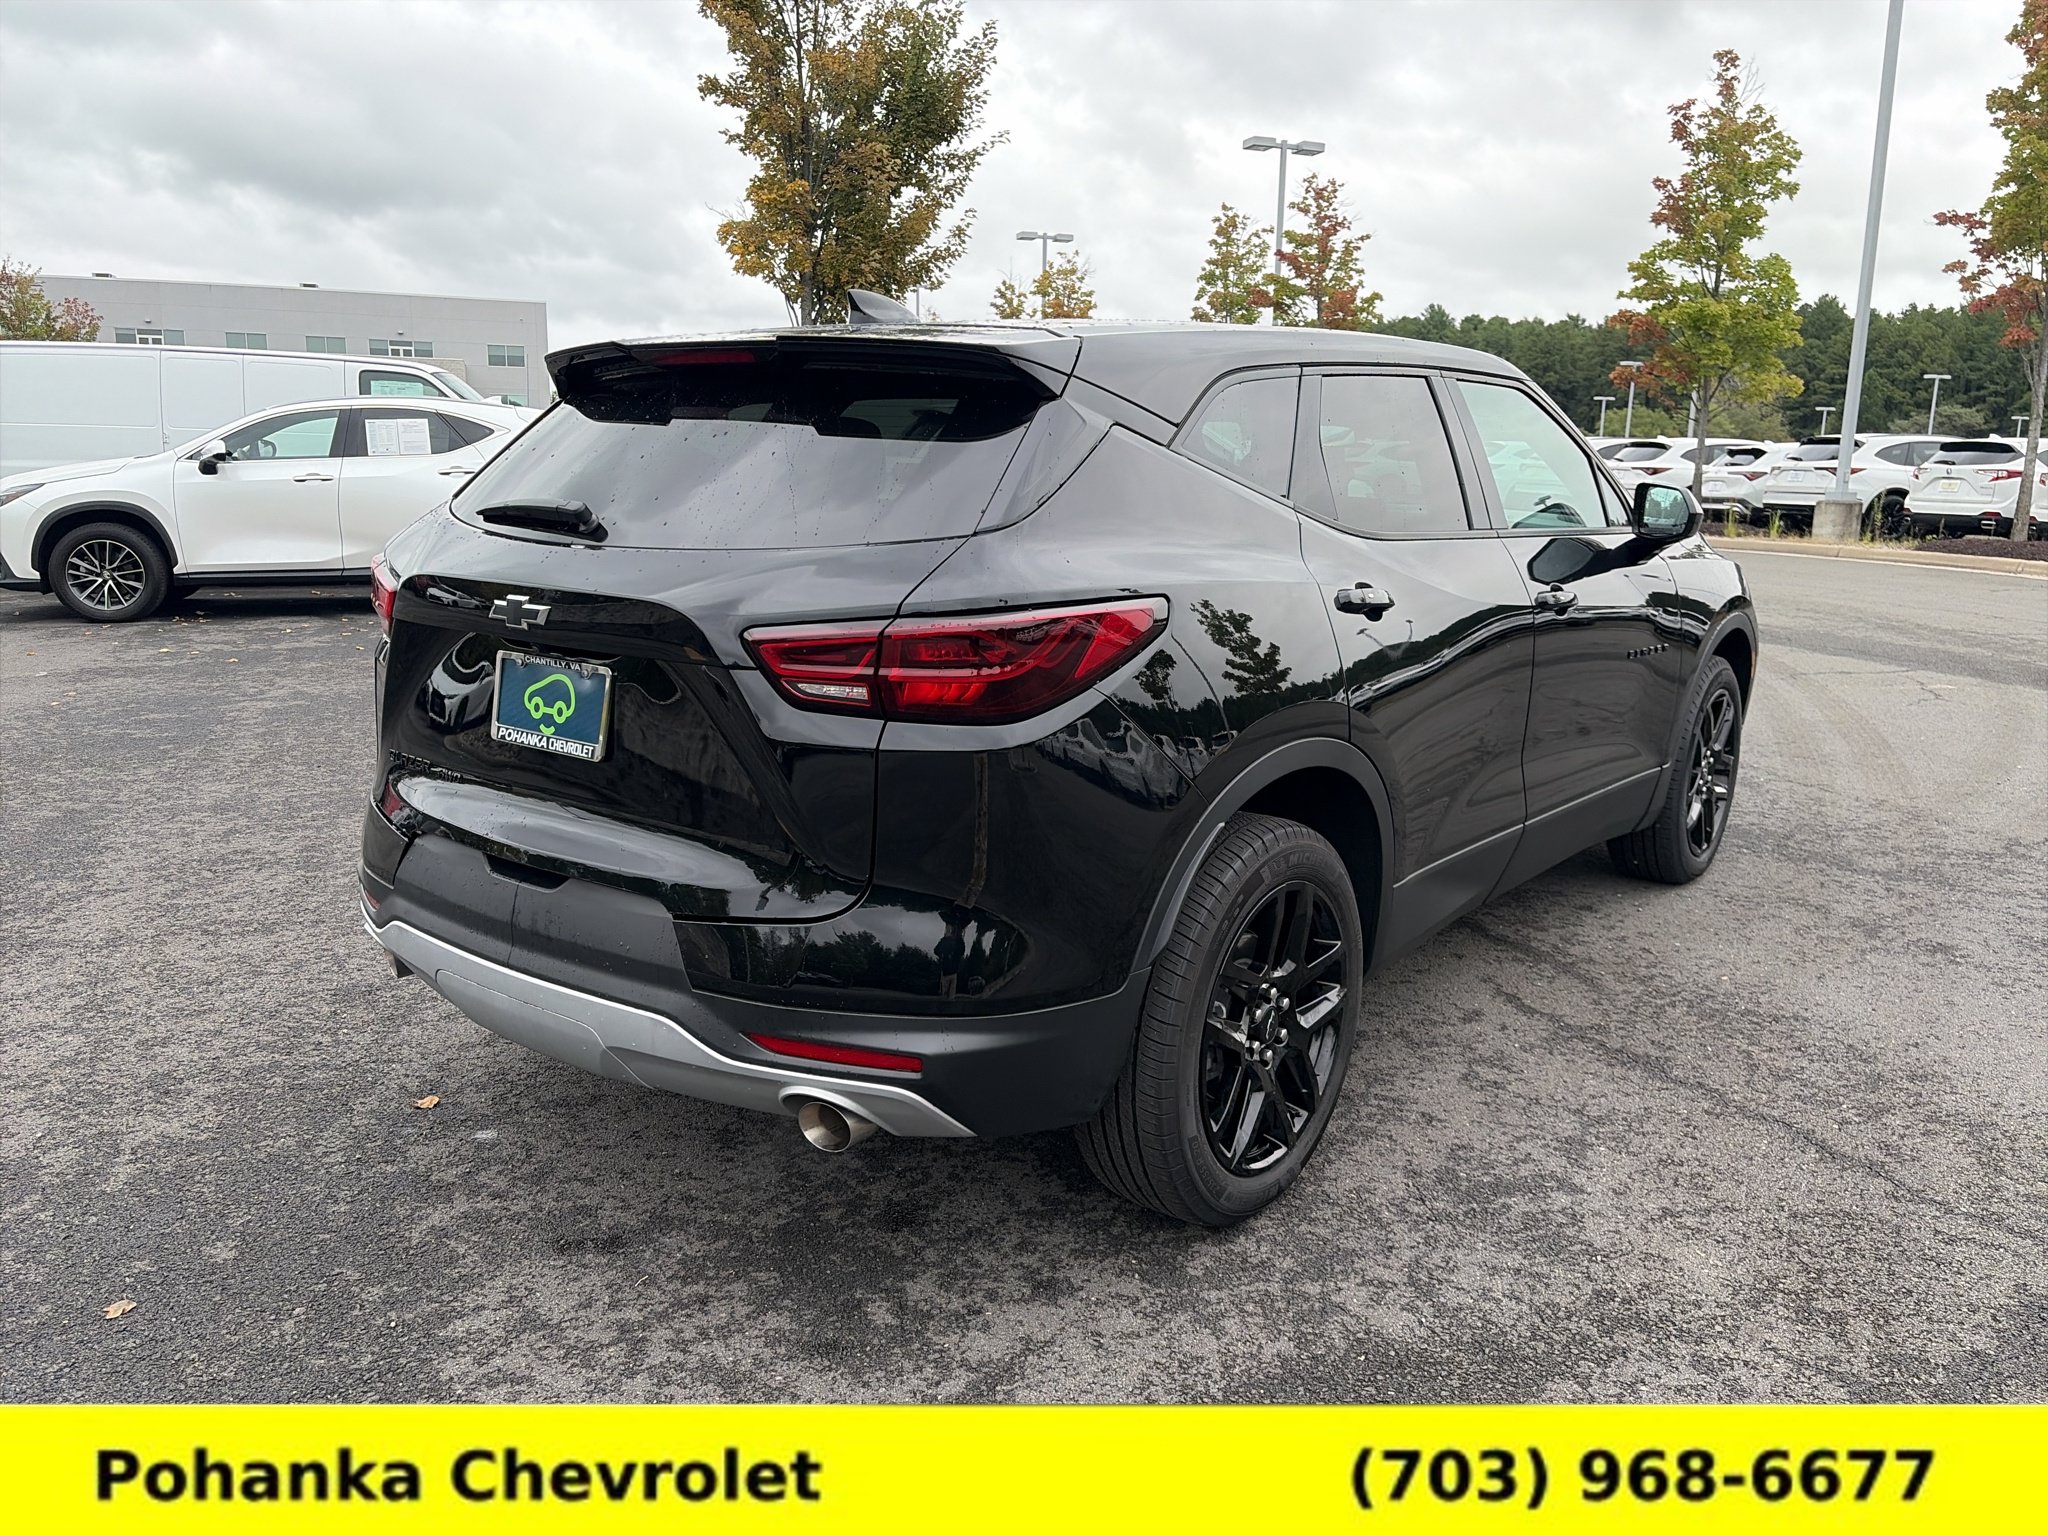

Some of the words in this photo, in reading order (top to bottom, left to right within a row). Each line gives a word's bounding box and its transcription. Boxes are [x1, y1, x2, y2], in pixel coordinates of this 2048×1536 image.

[570, 662, 581, 671] VA
[498, 728, 547, 749] POHANKA
[549, 738, 593, 758] CHEVROLET
